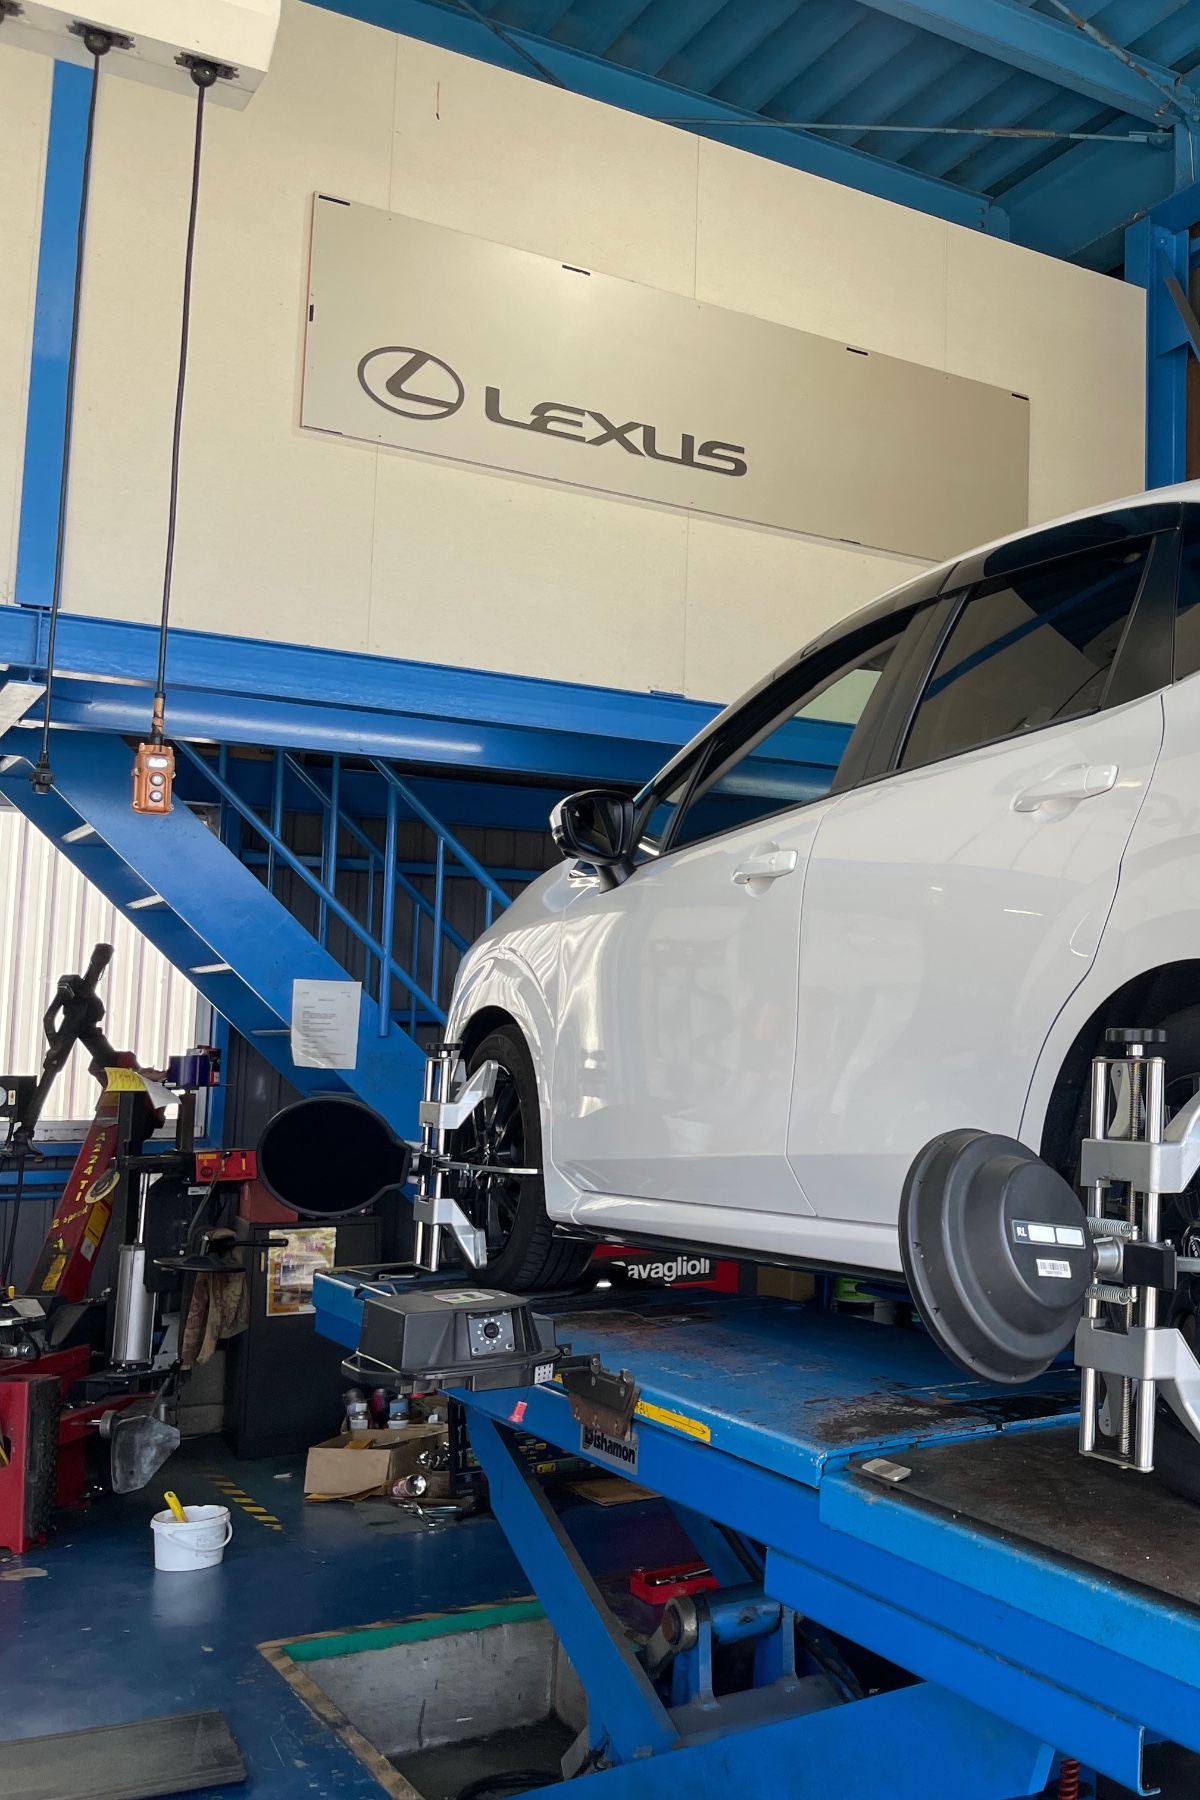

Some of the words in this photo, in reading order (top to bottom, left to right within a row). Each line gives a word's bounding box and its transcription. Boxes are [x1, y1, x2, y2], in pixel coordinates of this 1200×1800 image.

[484, 385, 749, 478] LEXUS
[1016, 1226, 1028, 1237] RL
[611, 1256, 710, 1282] avaglioli
